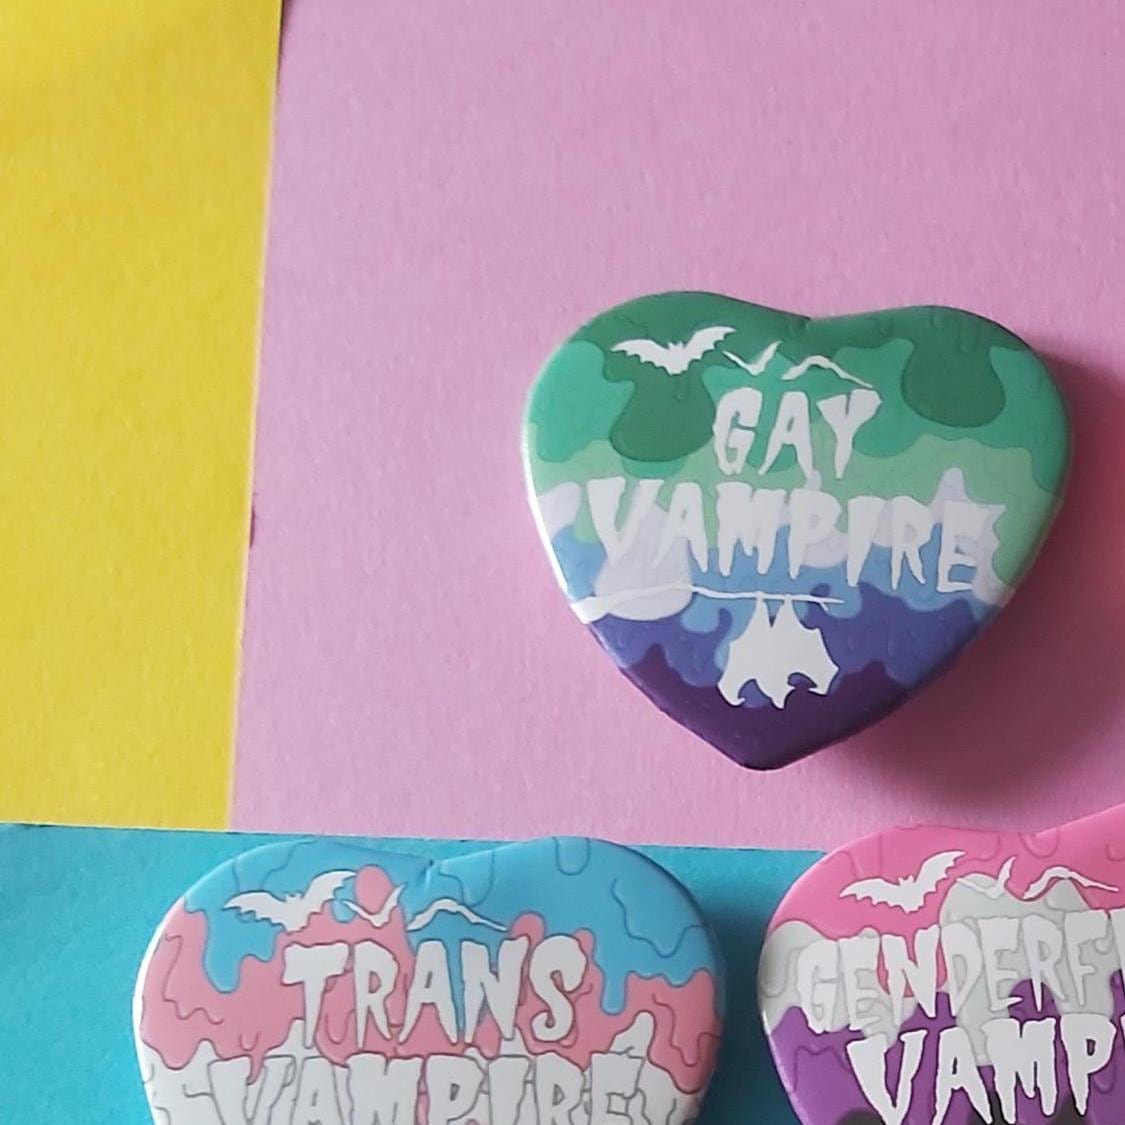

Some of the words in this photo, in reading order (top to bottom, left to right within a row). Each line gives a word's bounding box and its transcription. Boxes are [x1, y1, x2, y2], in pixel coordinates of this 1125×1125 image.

[713, 387, 883, 479] GAY
[586, 476, 1007, 594] VAMPIRE
[281, 935, 588, 1049] TRANS
